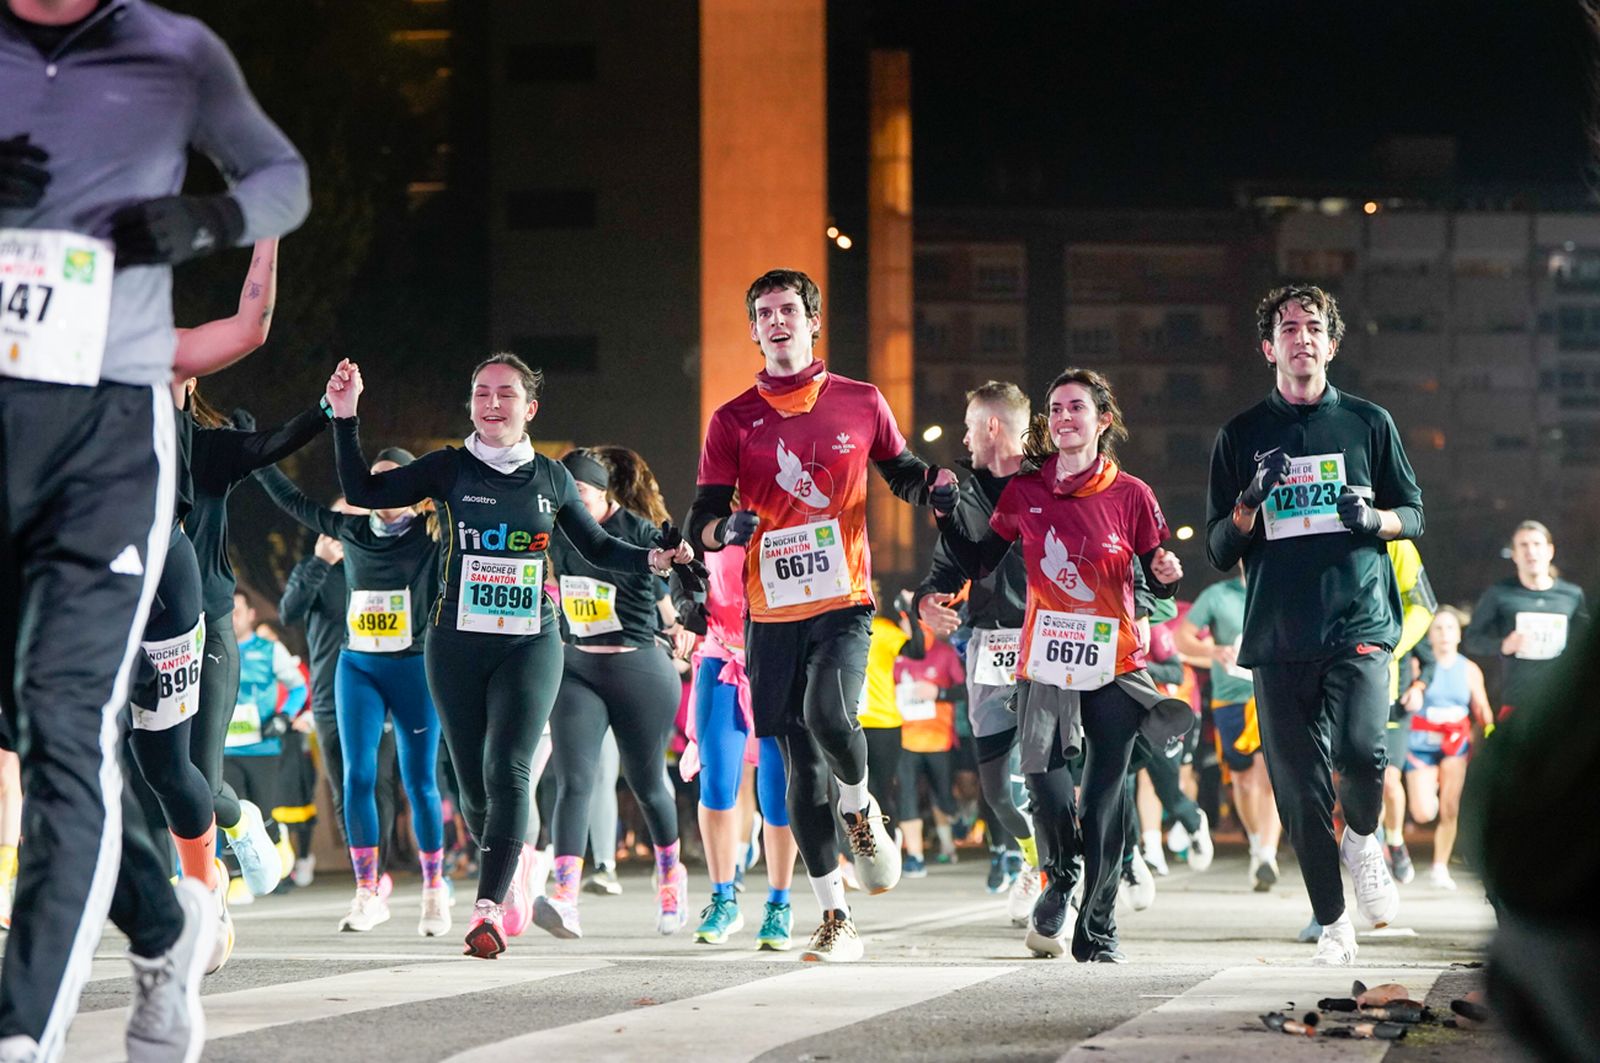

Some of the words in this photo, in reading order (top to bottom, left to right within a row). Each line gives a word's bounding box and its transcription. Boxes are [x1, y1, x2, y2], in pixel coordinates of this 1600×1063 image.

[1302, 464, 1312, 473] DE
[794, 478, 812, 497] 43
[1271, 482, 1338, 512] 12823
[458, 521, 550, 551] indea
[773, 536, 797, 547] NOCHE
[798, 534, 808, 543] DE
[765, 548, 781, 559] SAN
[481, 565, 506, 575] NOCHE
[507, 567, 517, 575] DE
[775, 550, 830, 580] 6675
[470, 573, 488, 582] SAN
[1056, 568, 1077, 590] 43
[470, 583, 533, 610] 13698
[573, 599, 597, 616] 1711
[357, 613, 398, 631] 3982
[1052, 621, 1076, 631] NOCHE
[1076, 623, 1087, 631] DE
[1042, 628, 1057, 638] SAN
[150, 648, 180, 660] NOCHE
[181, 643, 190, 654] DE
[993, 651, 1020, 667] 33
[1046, 639, 1099, 667] 6676
[160, 659, 199, 698] 896
